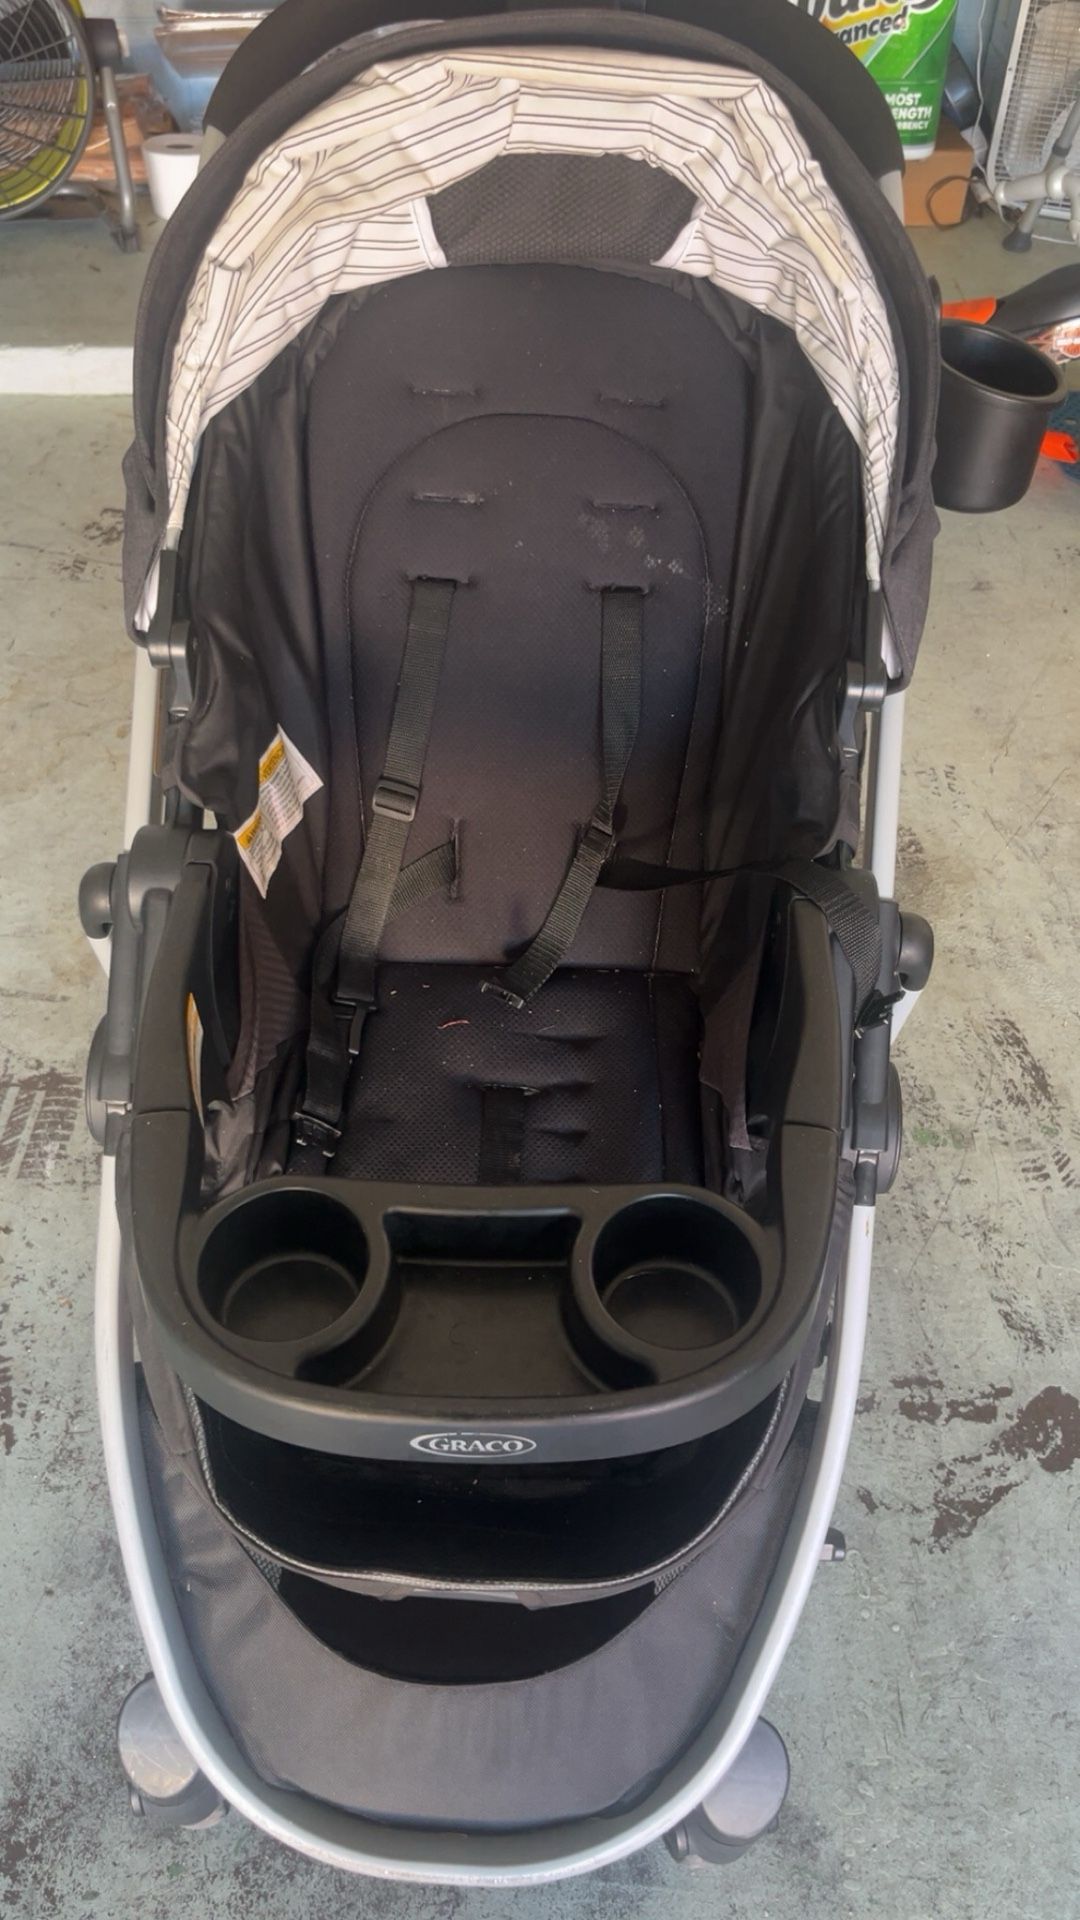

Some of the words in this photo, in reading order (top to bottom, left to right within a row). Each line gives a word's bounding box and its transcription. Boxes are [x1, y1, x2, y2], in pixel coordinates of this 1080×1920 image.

[838, 5, 908, 45] anced
[891, 105, 933, 120] ENGTH
[429, 1438, 524, 1452] GRACO
